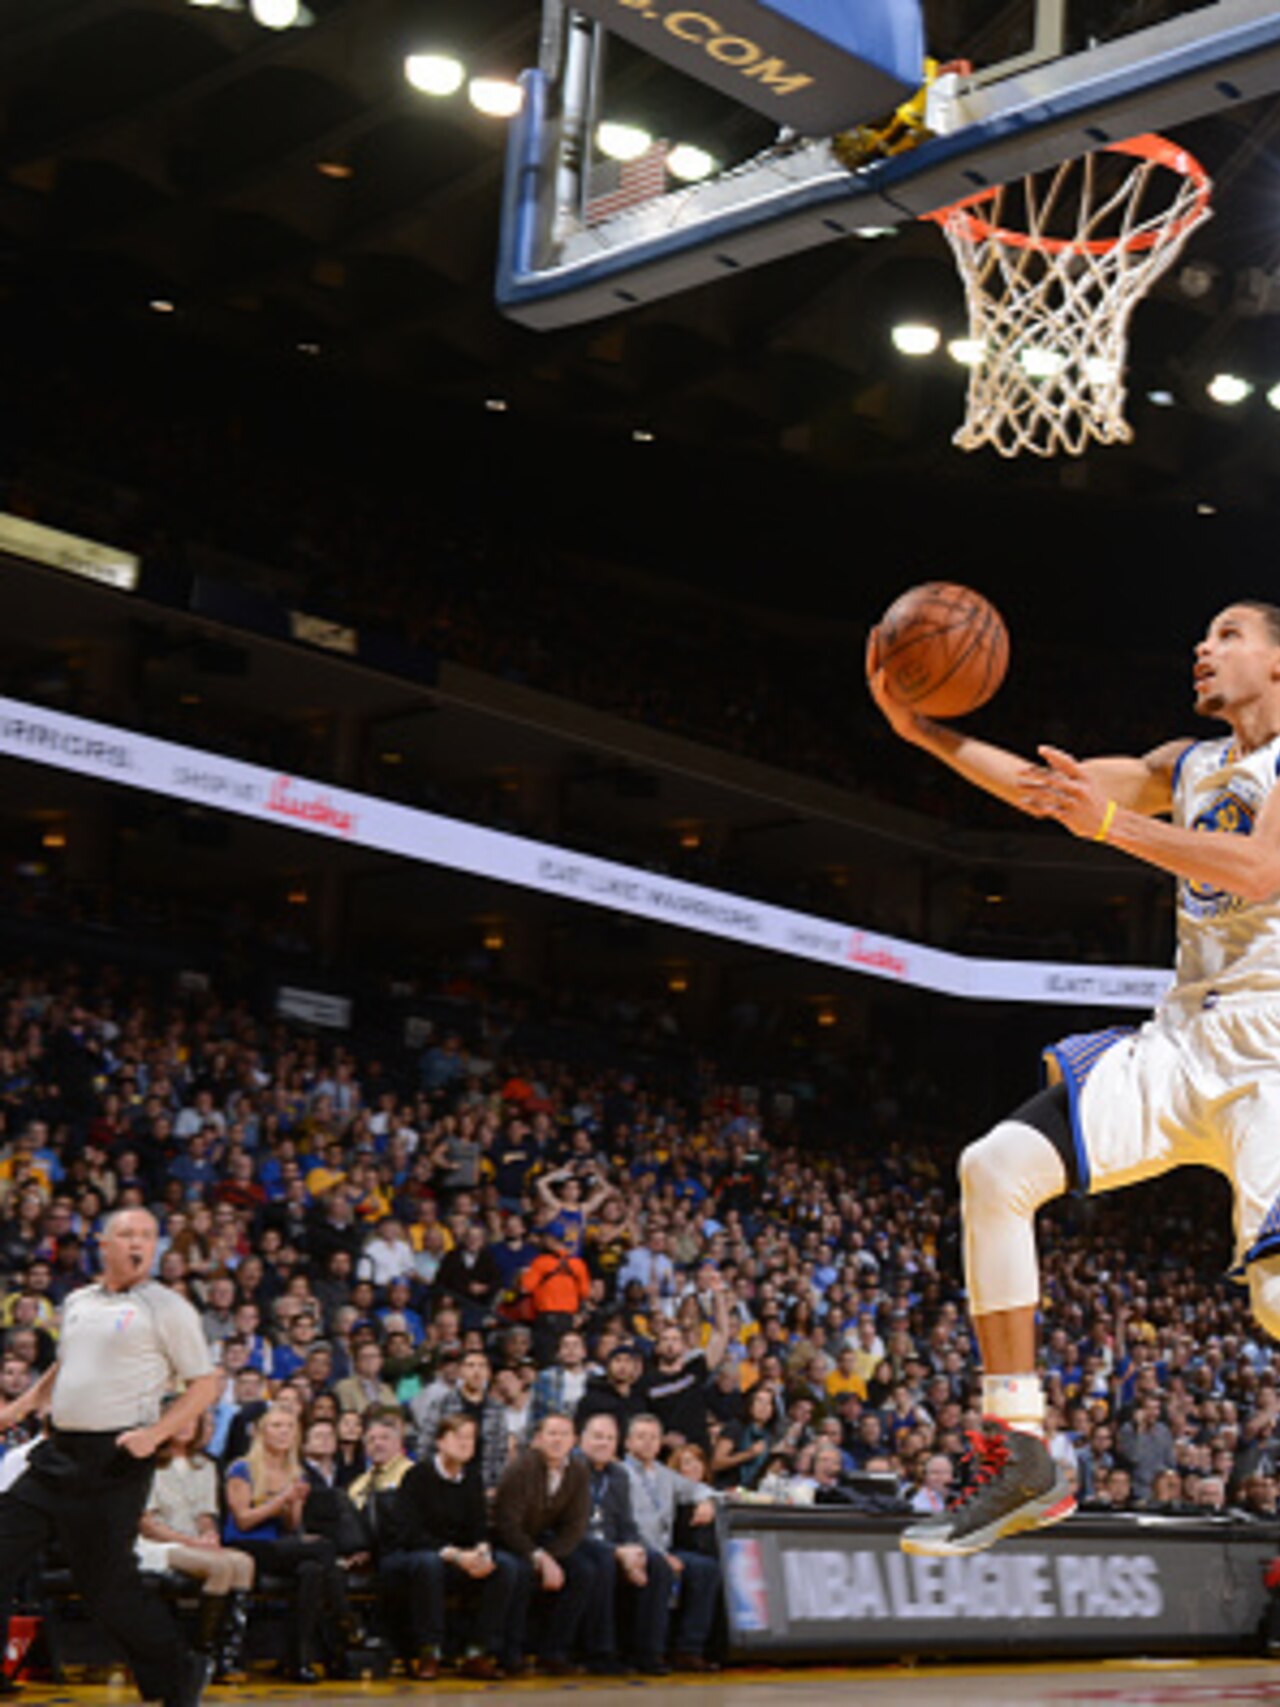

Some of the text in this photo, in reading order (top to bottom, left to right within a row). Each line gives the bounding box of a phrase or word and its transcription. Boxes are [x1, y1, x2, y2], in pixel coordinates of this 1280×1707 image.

[781, 1550, 1165, 1620] NBA LEAGUE PASS
